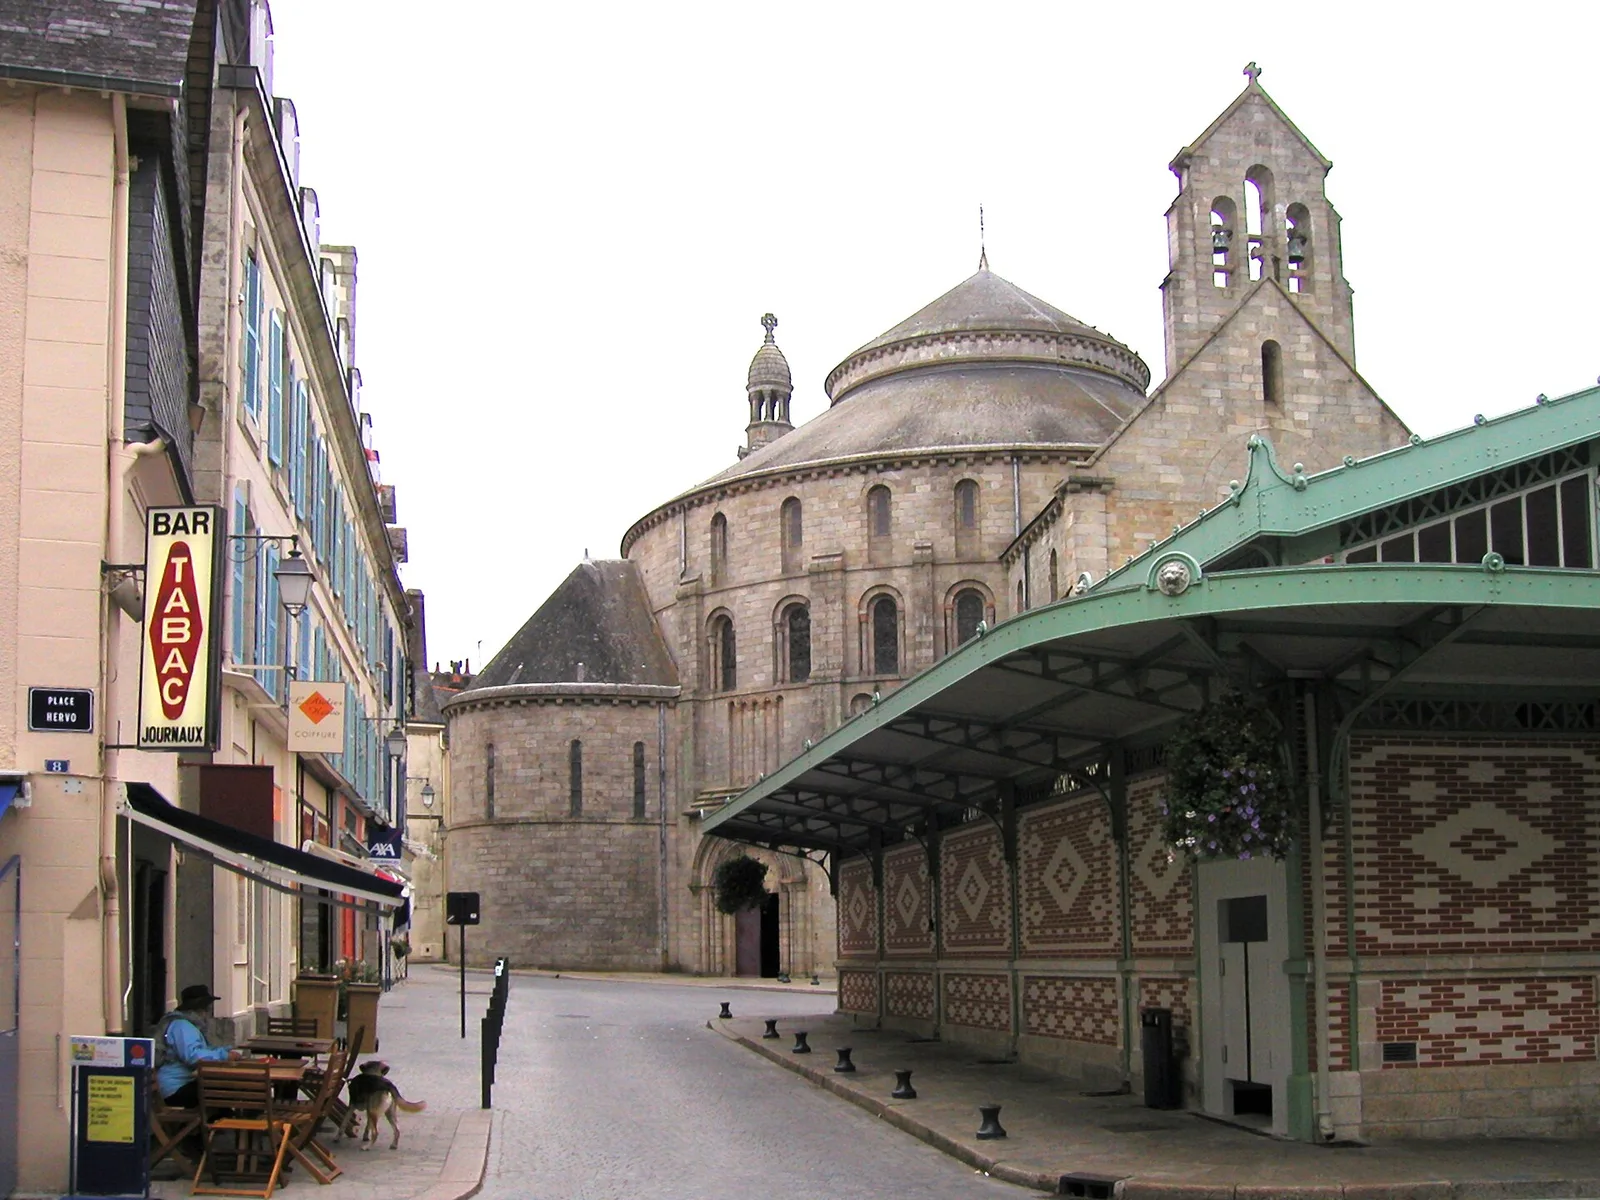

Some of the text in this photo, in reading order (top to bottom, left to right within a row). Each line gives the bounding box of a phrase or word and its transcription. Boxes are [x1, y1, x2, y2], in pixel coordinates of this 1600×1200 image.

[153, 511, 209, 536] BAR
[161, 557, 191, 706] TABAC
[48, 696, 75, 706] PLACE
[46, 712, 77, 723] HERVO
[141, 726, 203, 743] JOURNAUX
[294, 730, 337, 739] COIFFURE
[52, 761, 62, 772] 8
[369, 842, 396, 857] AXA
